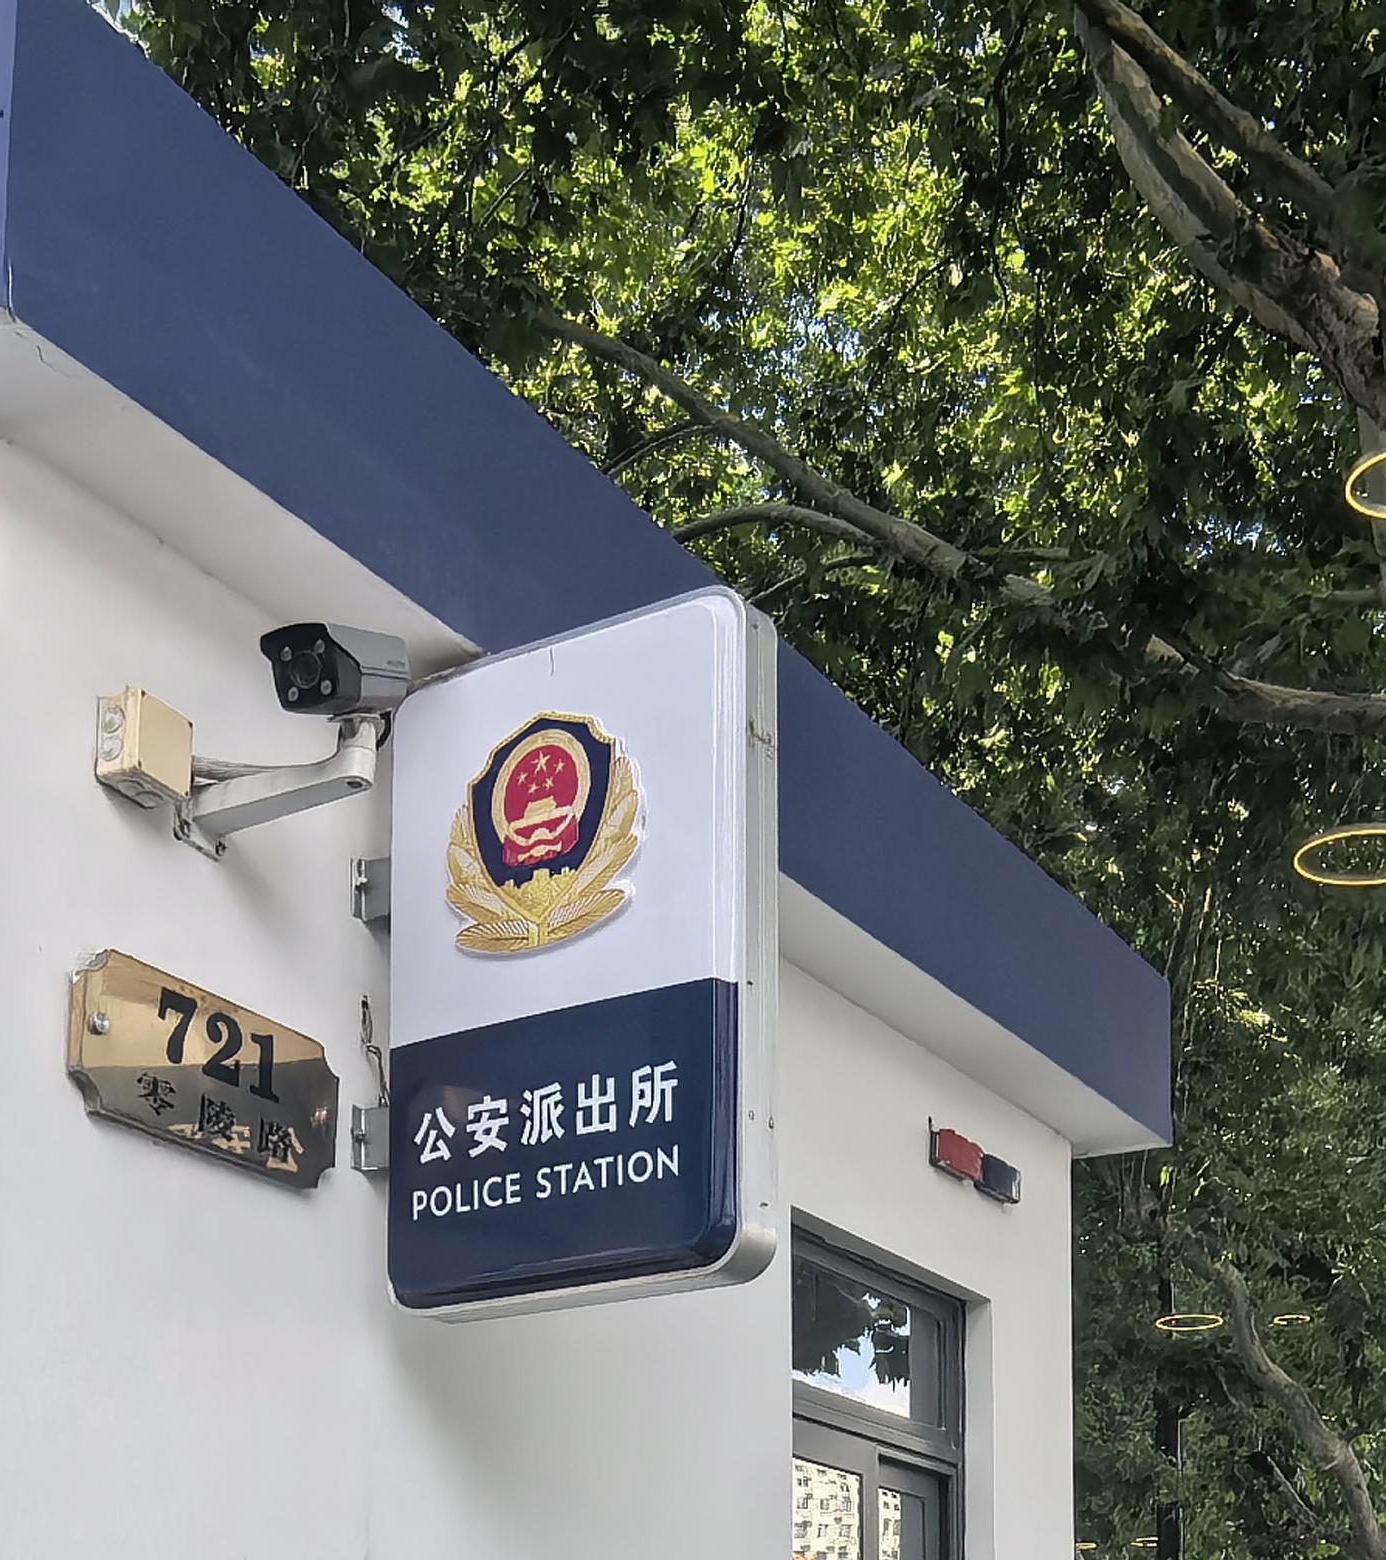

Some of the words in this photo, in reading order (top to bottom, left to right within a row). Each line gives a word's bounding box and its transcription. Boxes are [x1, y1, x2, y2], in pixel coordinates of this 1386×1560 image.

[158, 986, 280, 1104] 721
[135, 1071, 295, 1164] 零陵路
[413, 1060, 679, 1165] 公安派出所
[411, 1172, 522, 1221] POLICE
[535, 1144, 680, 1199] STATION
